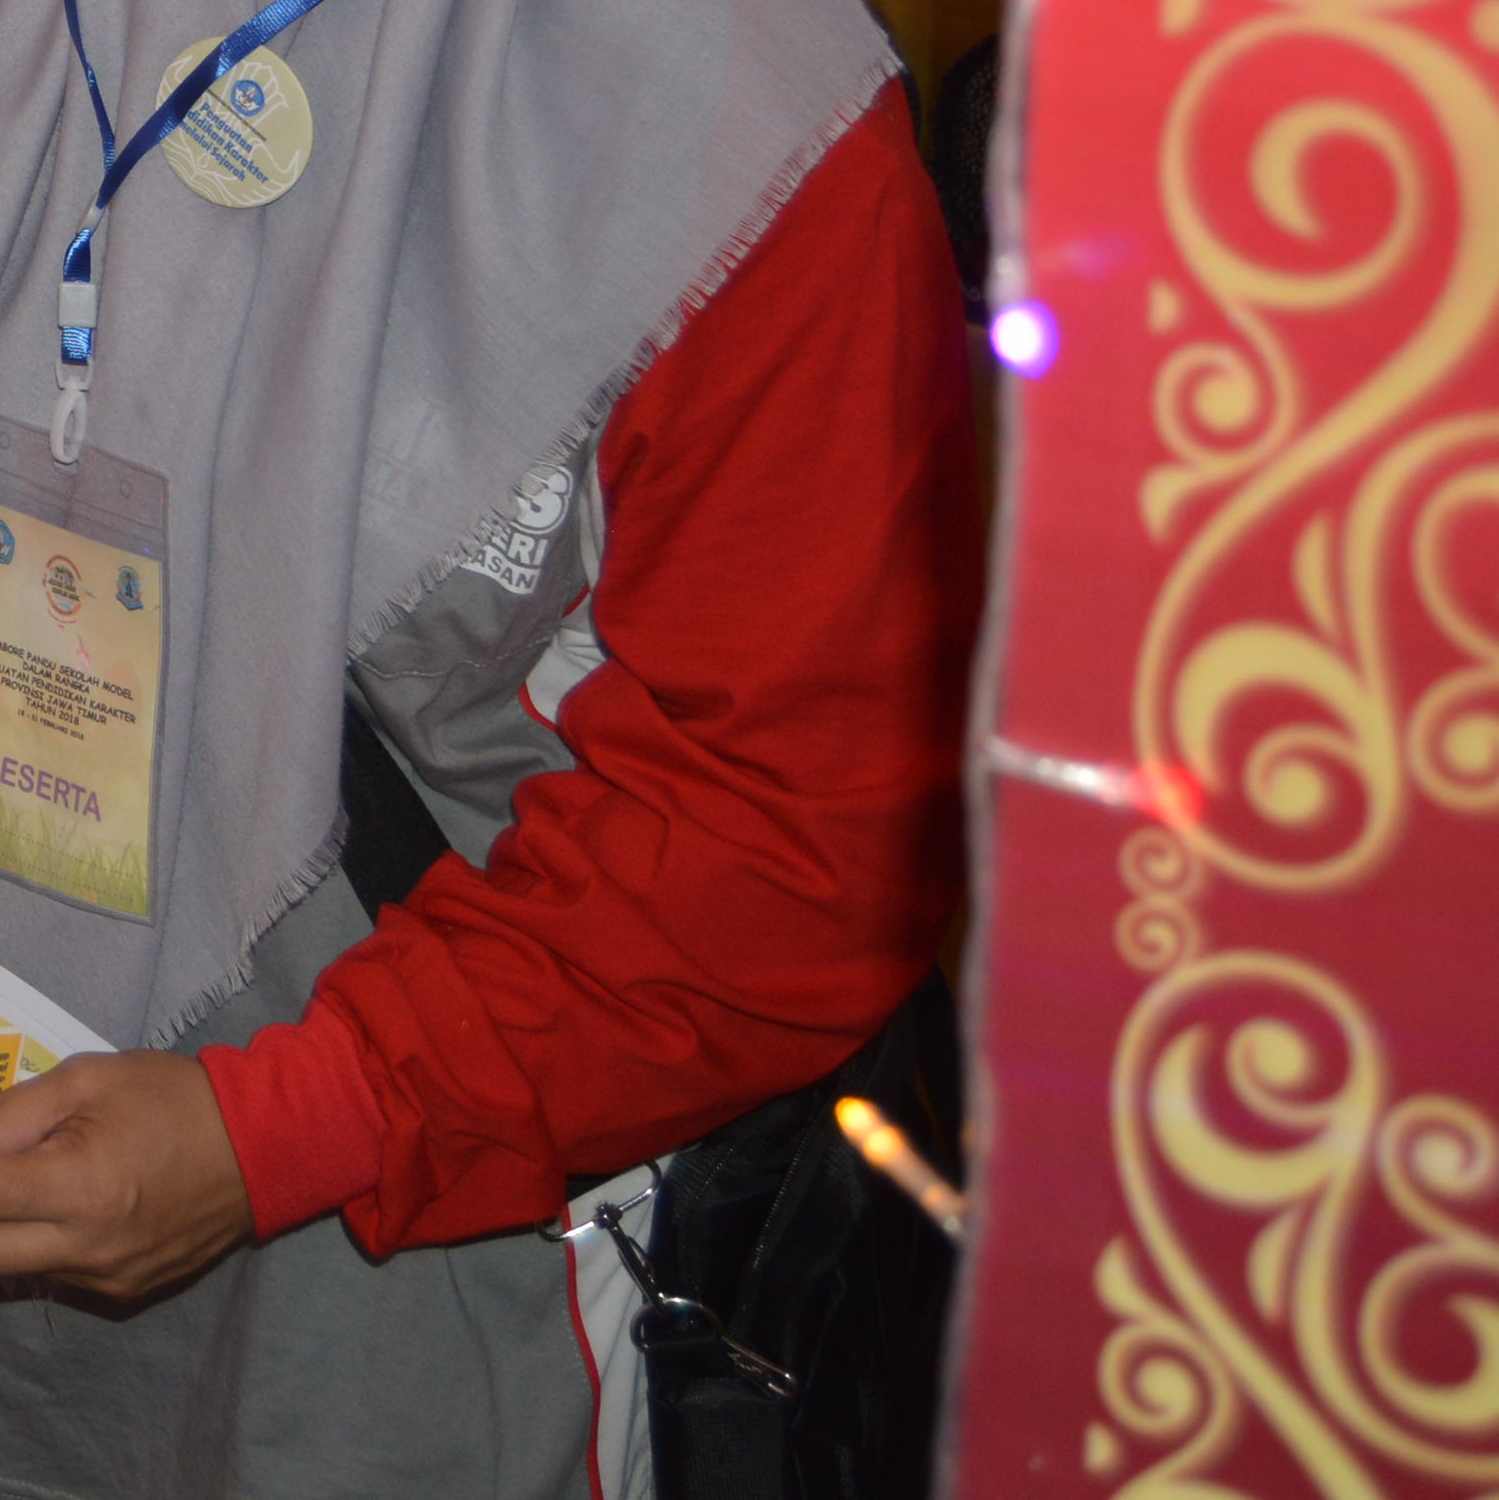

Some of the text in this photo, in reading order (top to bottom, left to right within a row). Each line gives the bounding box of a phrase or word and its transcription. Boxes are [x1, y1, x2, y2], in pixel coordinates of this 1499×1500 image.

[187, 109, 269, 183] didikan Karakter
[200, 101, 253, 153] Penguatan
[211, 147, 245, 181] Sejarah
[471, 548, 536, 590] ASAN
[22, 661, 90, 694] DALAM RANGKA
[27, 651, 56, 670] PANDU
[59, 665, 100, 687] SEKOLAH
[102, 680, 134, 700] MODEL
[0, 677, 107, 725] PROVINSI JAWA TIMUR
[25, 697, 79, 726] TAHUN 2018
[31, 676, 86, 704] PENDIDIKAN
[90, 700, 136, 724] KARAKTER
[40, 717, 68, 735] FEBRUARI
